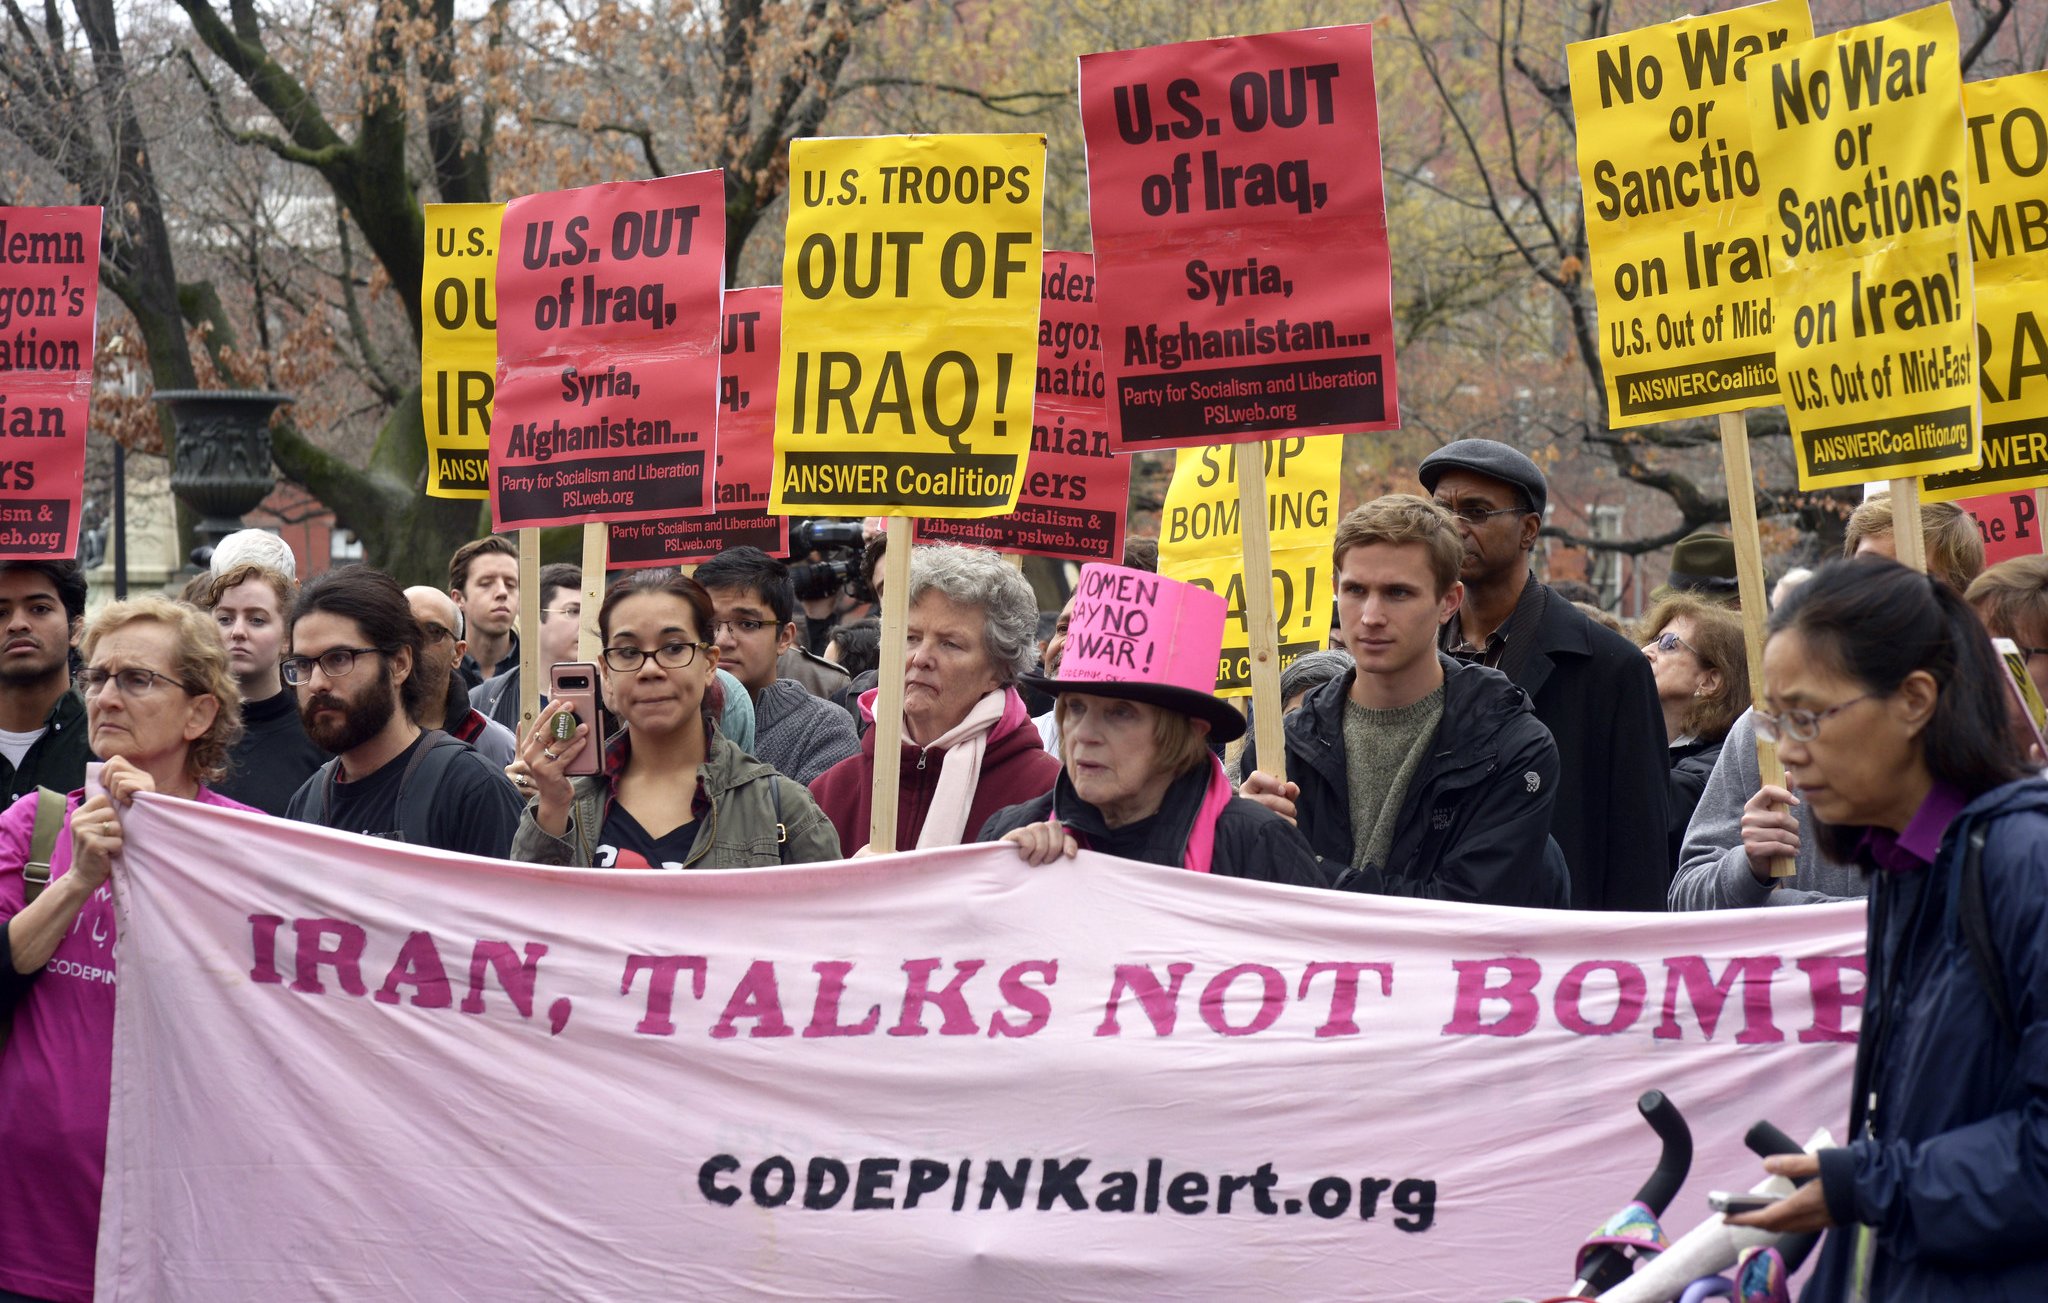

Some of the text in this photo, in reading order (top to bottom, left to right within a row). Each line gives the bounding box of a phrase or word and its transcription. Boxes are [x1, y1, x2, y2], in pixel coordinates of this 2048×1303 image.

[1597, 46, 1663, 109] No
[1771, 35, 1937, 130] No War
[1114, 63, 1339, 145] U.S. OUT
[1669, 100, 1715, 143] or
[1834, 122, 1873, 171] or
[803, 165, 1030, 207] U.S. TROOPS
[1141, 150, 1328, 216] of Iraq,
[1593, 138, 1760, 222] Sanctio
[1777, 167, 1962, 258] Sanctions
[437, 227, 493, 257] U.S.
[522, 205, 701, 270] U.S. OUT
[797, 231, 1032, 300] OUT OF
[1185, 258, 1293, 306] Syria,
[1614, 256, 1668, 301] on
[535, 276, 676, 331] of Iraq,
[1793, 252, 1962, 348] on Iran!
[1124, 318, 1370, 370] Afghanistan...
[1611, 317, 1651, 358] U.S.
[1656, 310, 1694, 351] Out
[1701, 304, 1724, 345] of
[562, 366, 640, 406] Syria,
[791, 350, 1013, 454] IRAQ!
[1124, 369, 1377, 407] Party for Socialism and Liberation
[1788, 345, 1972, 412] U.S. Out of Mid-East
[437, 371, 494, 436] IR
[1204, 402, 1297, 425] PSLweb.org
[506, 420, 698, 461] Afghanistan...
[1813, 424, 1969, 465] ANSWERCoalition.org
[502, 463, 699, 493] Party for Socialism and Liberation
[563, 489, 635, 508] PSLweb.org
[784, 464, 1013, 496] ANSWER Coalition
[37, 504, 53, 521] &
[612, 516, 776, 539] Party for Socialism and Liberation
[923, 518, 1109, 554] Liberation pslweb.org
[1088, 514, 1101, 529] &
[1169, 489, 1328, 543] BOMING
[665, 538, 722, 552] PSLweb.org
[1101, 605, 1148, 637] NO
[248, 914, 572, 1035] IRAN,
[620, 954, 1059, 1039] TALKS
[1093, 961, 1395, 1038] NOT
[697, 1153, 1437, 1233] CODEPINKalert.org
